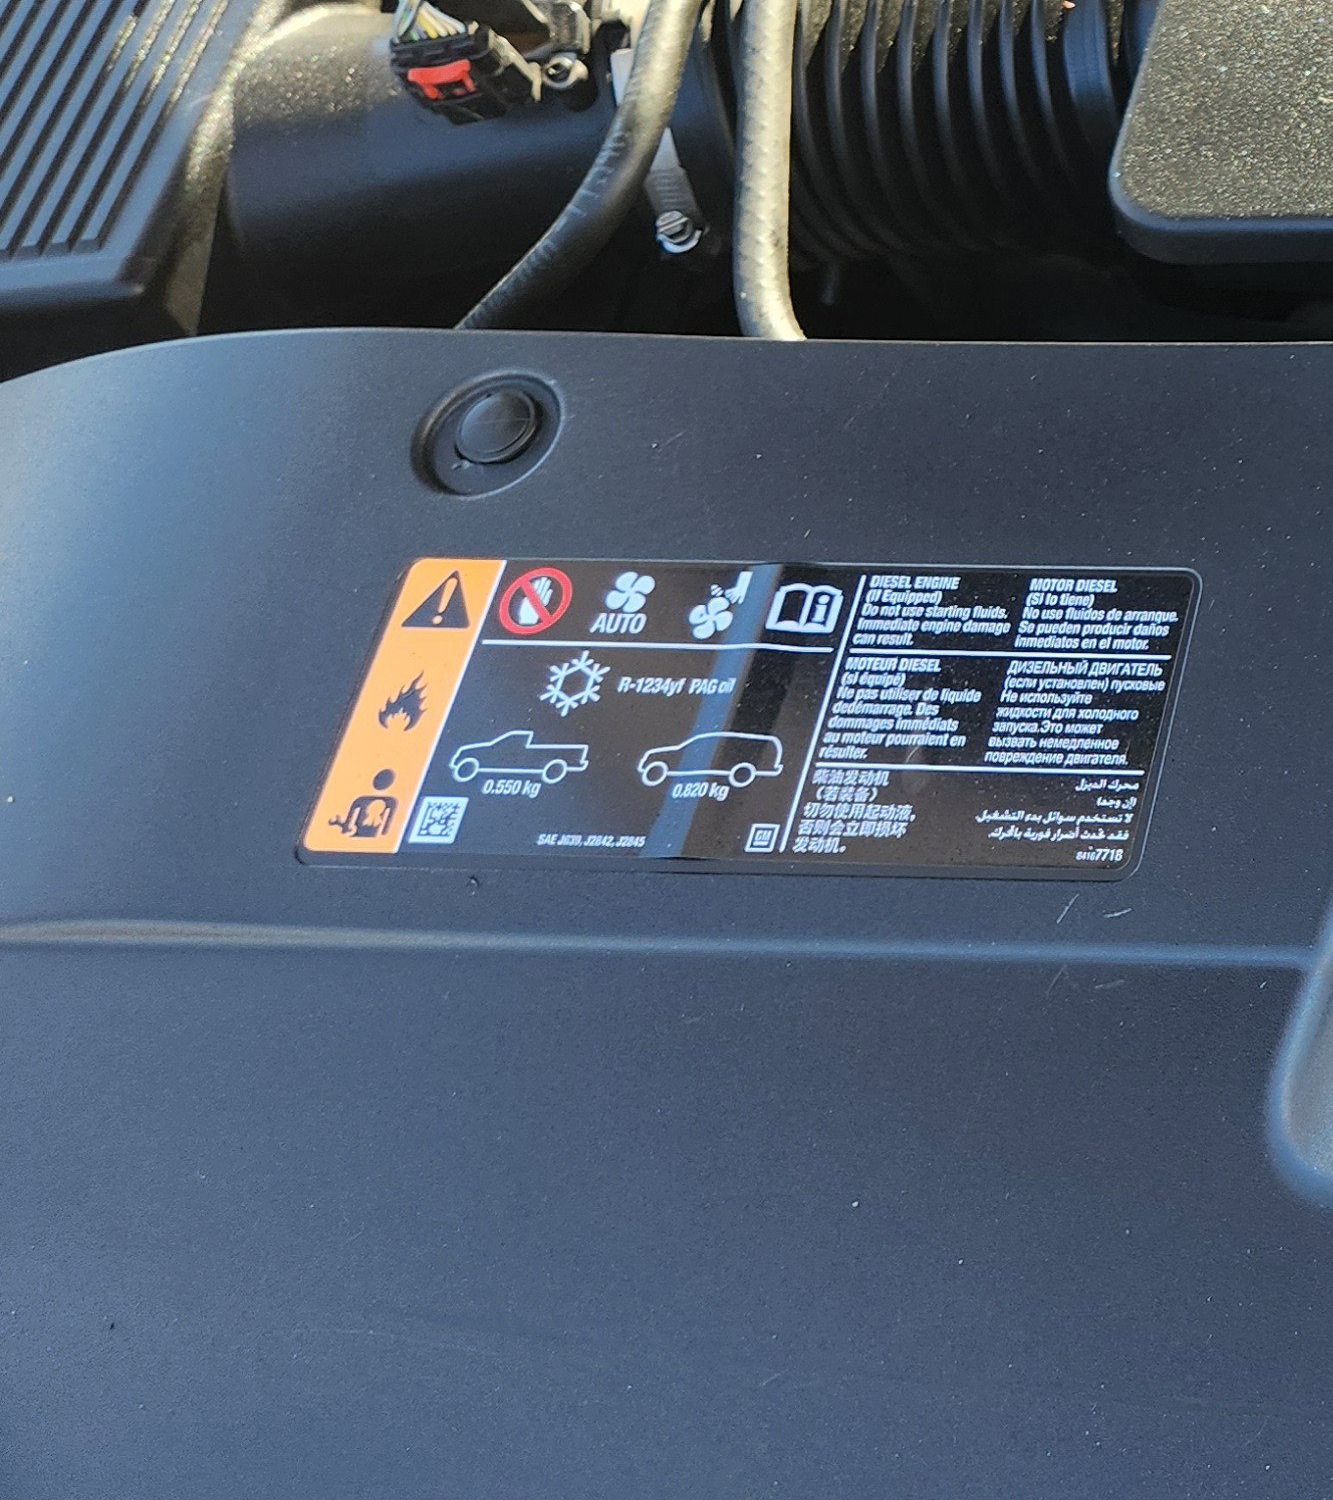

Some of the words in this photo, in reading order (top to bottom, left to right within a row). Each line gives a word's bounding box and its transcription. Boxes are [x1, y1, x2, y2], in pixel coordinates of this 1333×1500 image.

[870, 576, 912, 589] DIESEL
[914, 577, 961, 590] ENGINE
[1030, 579, 1073, 591] MOTOR
[1076, 580, 1118, 592] DIESEL
[882, 590, 942, 605] Equipped)
[1026, 593, 1044, 606] (Si
[1060, 594, 1094, 608] tiene)
[862, 604, 879, 616] Do
[880, 605, 900, 616] not
[902, 607, 924, 617] use
[926, 606, 970, 620] starting
[972, 606, 1008, 619] fluids.
[1023, 607, 1039, 619] No
[1041, 609, 1062, 620] use
[1065, 609, 1104, 620] fluidos
[1107, 609, 1122, 620] de
[1124, 611, 1178, 623] arranque.
[590, 613, 647, 633] AUTO
[858, 618, 919, 631] Immediate
[921, 620, 961, 634] engine
[963, 620, 1011, 635] damage
[1018, 621, 1034, 633] Se
[1036, 622, 1080, 635] pueden
[1082, 623, 1132, 636] producir
[1133, 624, 1170, 636] daños
[853, 634, 875, 645] can
[877, 634, 914, 645] result.
[1081, 638, 1096, 649] en
[1100, 637, 1111, 649] el
[1112, 638, 1149, 650] motor.
[845, 657, 898, 671] MOTEUR
[898, 658, 941, 672] DIESEL
[1007, 660, 1088, 676] ДИЗЕЛЬНЫЙ
[1088, 662, 1163, 677] ДВИГАТЕЛЬ
[617, 677, 685, 697] R-1234yf
[689, 678, 717, 694] PAG
[718, 678, 737, 693] oil
[841, 673, 858, 686] (si
[859, 673, 905, 687] équipé)
[1004, 676, 1038, 689] (если
[1037, 678, 1109, 692] установлен)
[1111, 679, 1165, 693] пусковые
[837, 687, 853, 699] Ne
[855, 689, 878, 700] pas
[880, 689, 922, 701] utiliser
[923, 689, 938, 701] de
[940, 689, 981, 704] liquide
[1000, 690, 1018, 703] Не
[1020, 692, 1093, 706] используйте
[832, 701, 913, 717] dedémarrage.
[916, 703, 939, 715] Des
[996, 707, 1052, 719] жидкости
[1052, 708, 1076, 720] для
[1078, 709, 1139, 721] холодного
[828, 716, 894, 732] dommages
[1064, 724, 1103, 734] может
[823, 732, 840, 743] au
[842, 732, 884, 744] moteur
[886, 733, 947, 747] pourraient
[950, 735, 966, 747] en
[988, 737, 1037, 748] вызвать
[1039, 737, 1119, 750] немедленное
[819, 746, 868, 759] résulter.
[984, 752, 1063, 765] повреждение
[1064, 753, 1128, 767] двигателя.
[812, 770, 890, 786] 柴油发动机
[1108, 779, 1139, 792] محرك
[482, 779, 521, 795] 0.550
[522, 781, 540, 798] kg
[672, 782, 708, 798] 0.820
[709, 784, 729, 801] kg
[754, 830, 770, 841] GM
[798, 819, 908, 838] 否则会立即损坏
[537, 834, 556, 846] SAE
